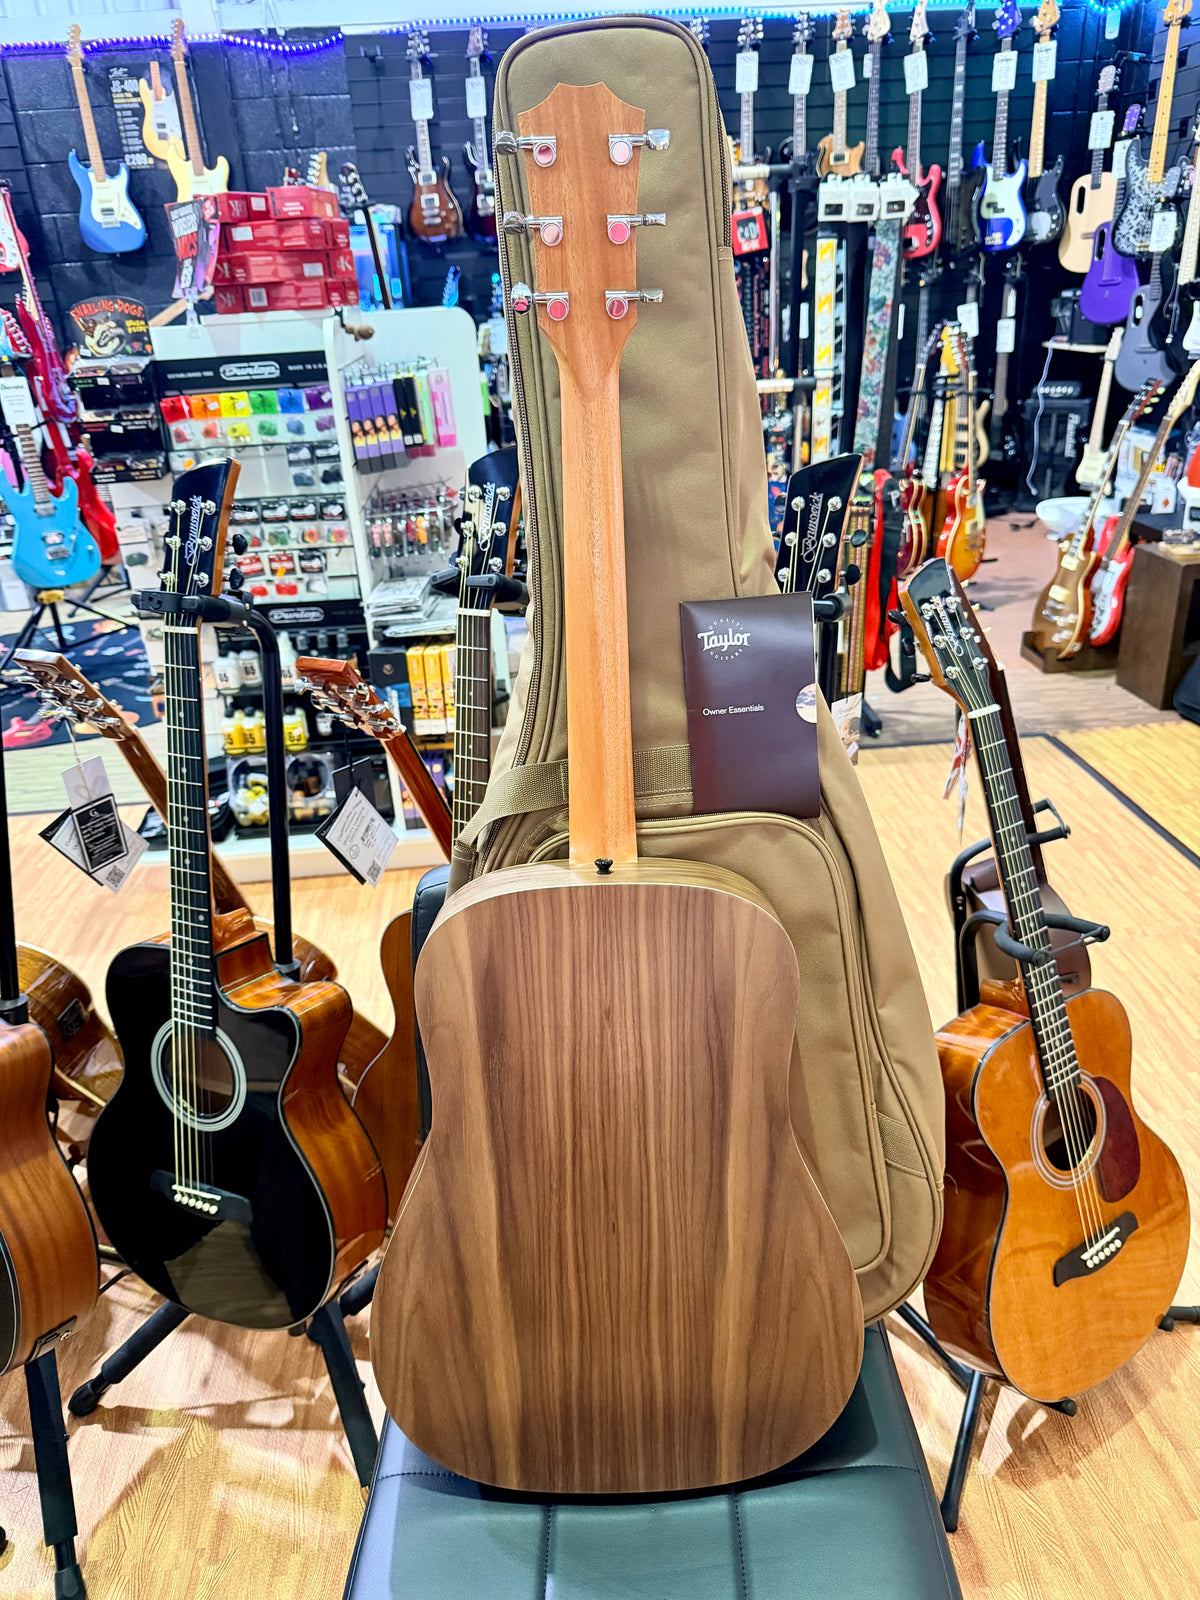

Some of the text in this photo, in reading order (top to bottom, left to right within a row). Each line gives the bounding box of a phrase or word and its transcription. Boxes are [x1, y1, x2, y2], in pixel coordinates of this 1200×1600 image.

[477, 481, 496, 552] Brunswick
[800, 491, 824, 563] Brunswick
[184, 494, 202, 567] Brunswick
[708, 617, 743, 631] QUALITY
[697, 627, 751, 652] Taylor
[709, 648, 743, 661] GUITARS
[702, 703, 765, 716] Owner Essentials
